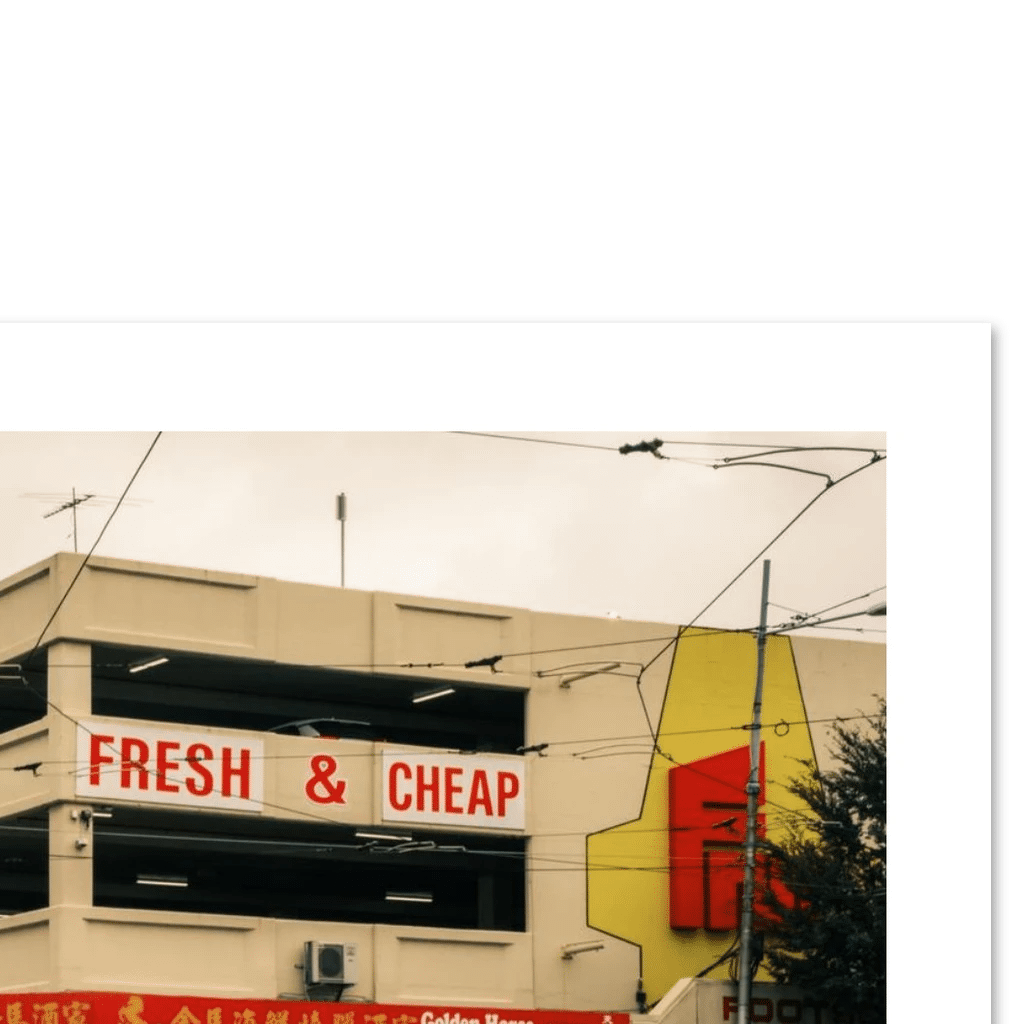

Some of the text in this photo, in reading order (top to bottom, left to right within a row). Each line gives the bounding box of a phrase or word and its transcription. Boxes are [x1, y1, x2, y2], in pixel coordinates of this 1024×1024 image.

[89, 734, 520, 817] FRESH & CHEAP
